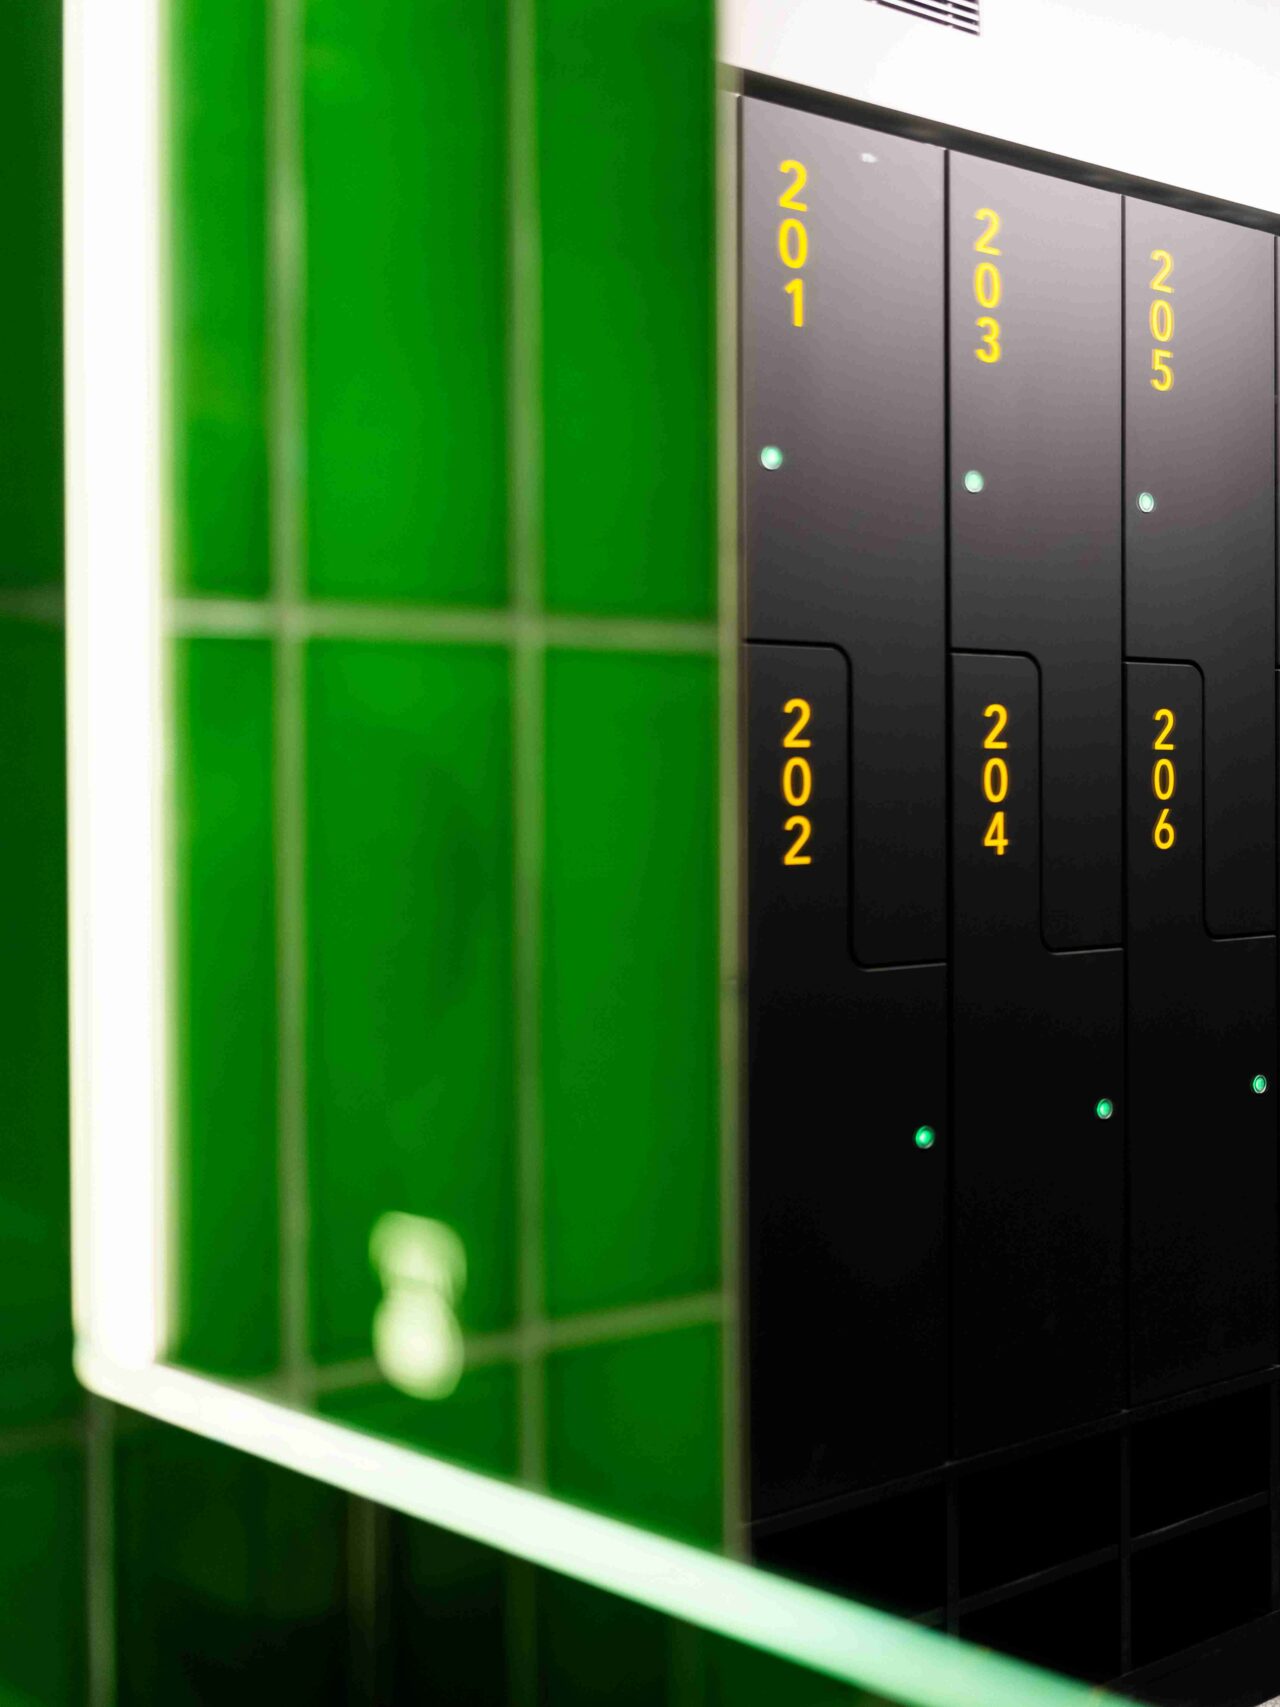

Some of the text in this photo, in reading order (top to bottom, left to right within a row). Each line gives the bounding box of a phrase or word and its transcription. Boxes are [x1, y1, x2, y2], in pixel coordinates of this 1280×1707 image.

[776, 160, 810, 328] 201
[973, 208, 1002, 364] 203
[1149, 249, 1175, 391] 205
[781, 697, 814, 866] 202
[981, 703, 1010, 856] 204
[1152, 708, 1177, 850] 206
